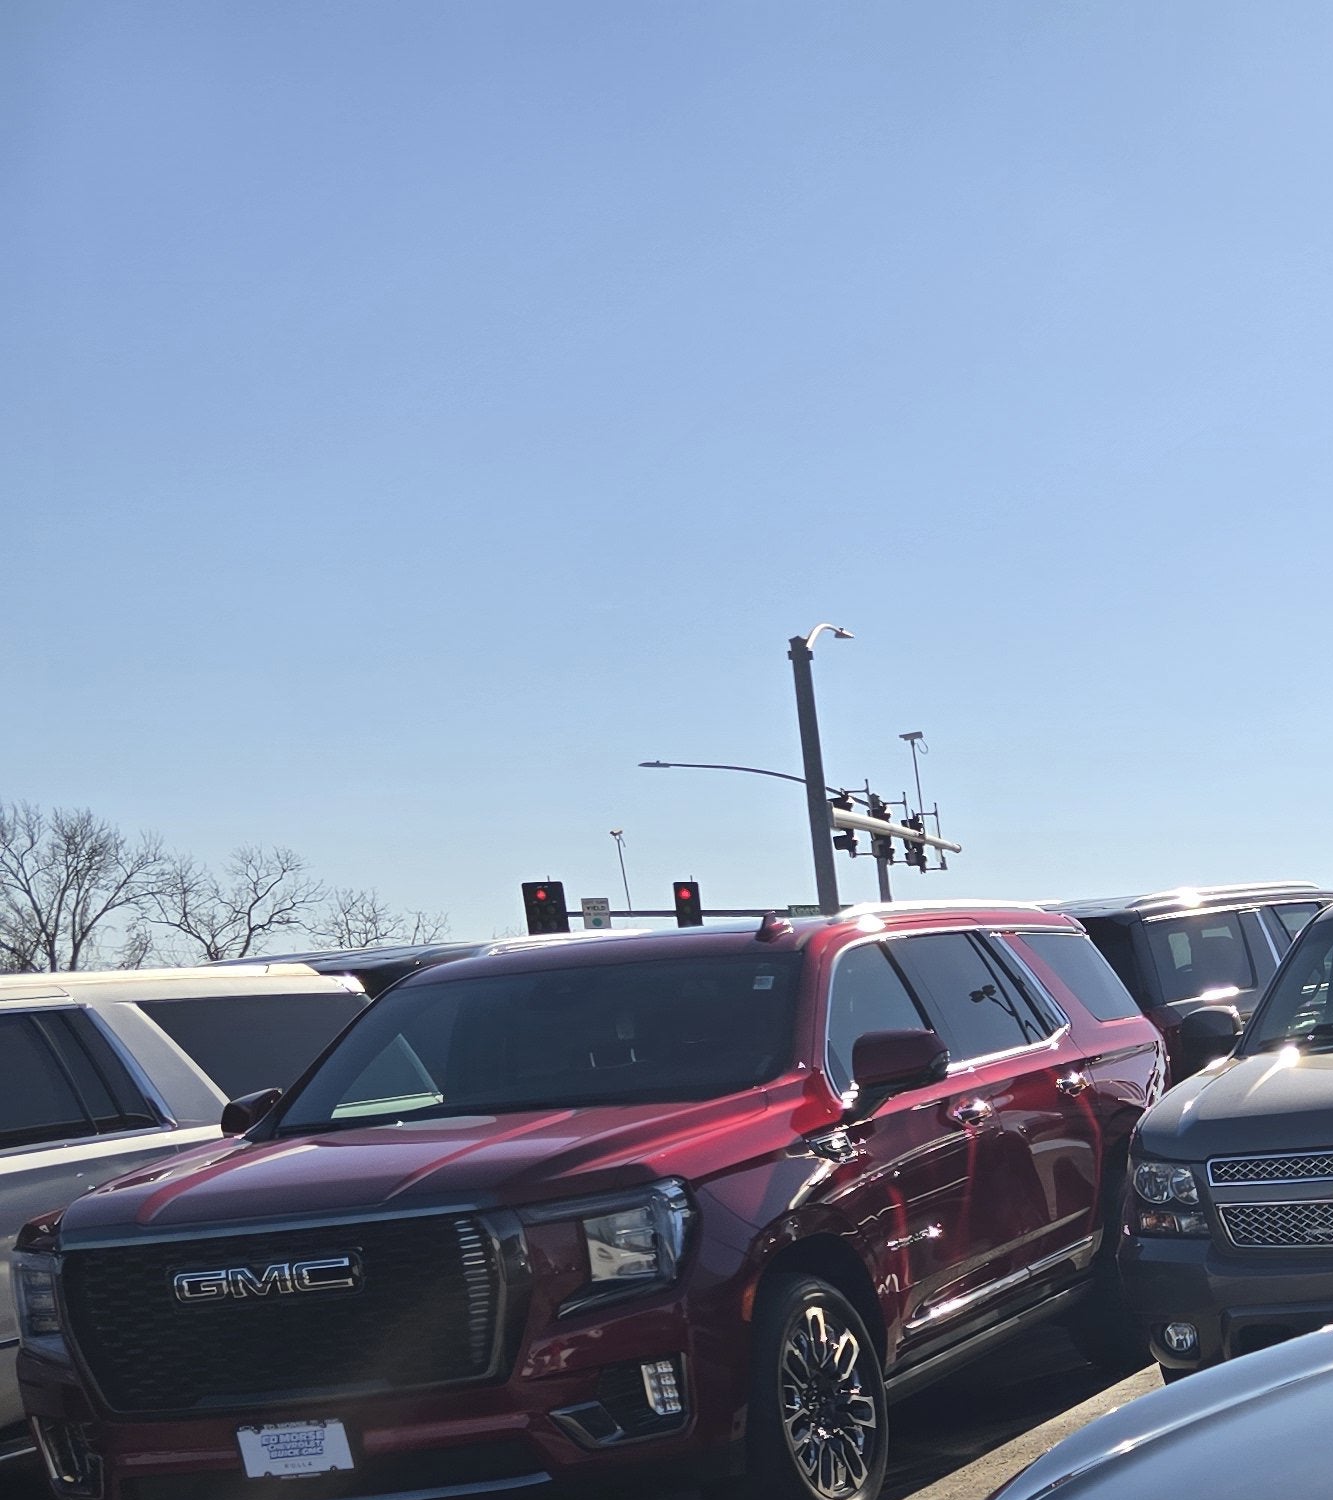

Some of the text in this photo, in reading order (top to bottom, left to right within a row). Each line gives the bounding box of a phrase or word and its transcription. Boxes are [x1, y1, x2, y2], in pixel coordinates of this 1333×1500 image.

[173, 1257, 354, 1304] GMC
[262, 1430, 324, 1445] ED MORSE
[268, 1441, 323, 1451] CHEVROLET
[270, 1447, 323, 1458] BUICK GMC
